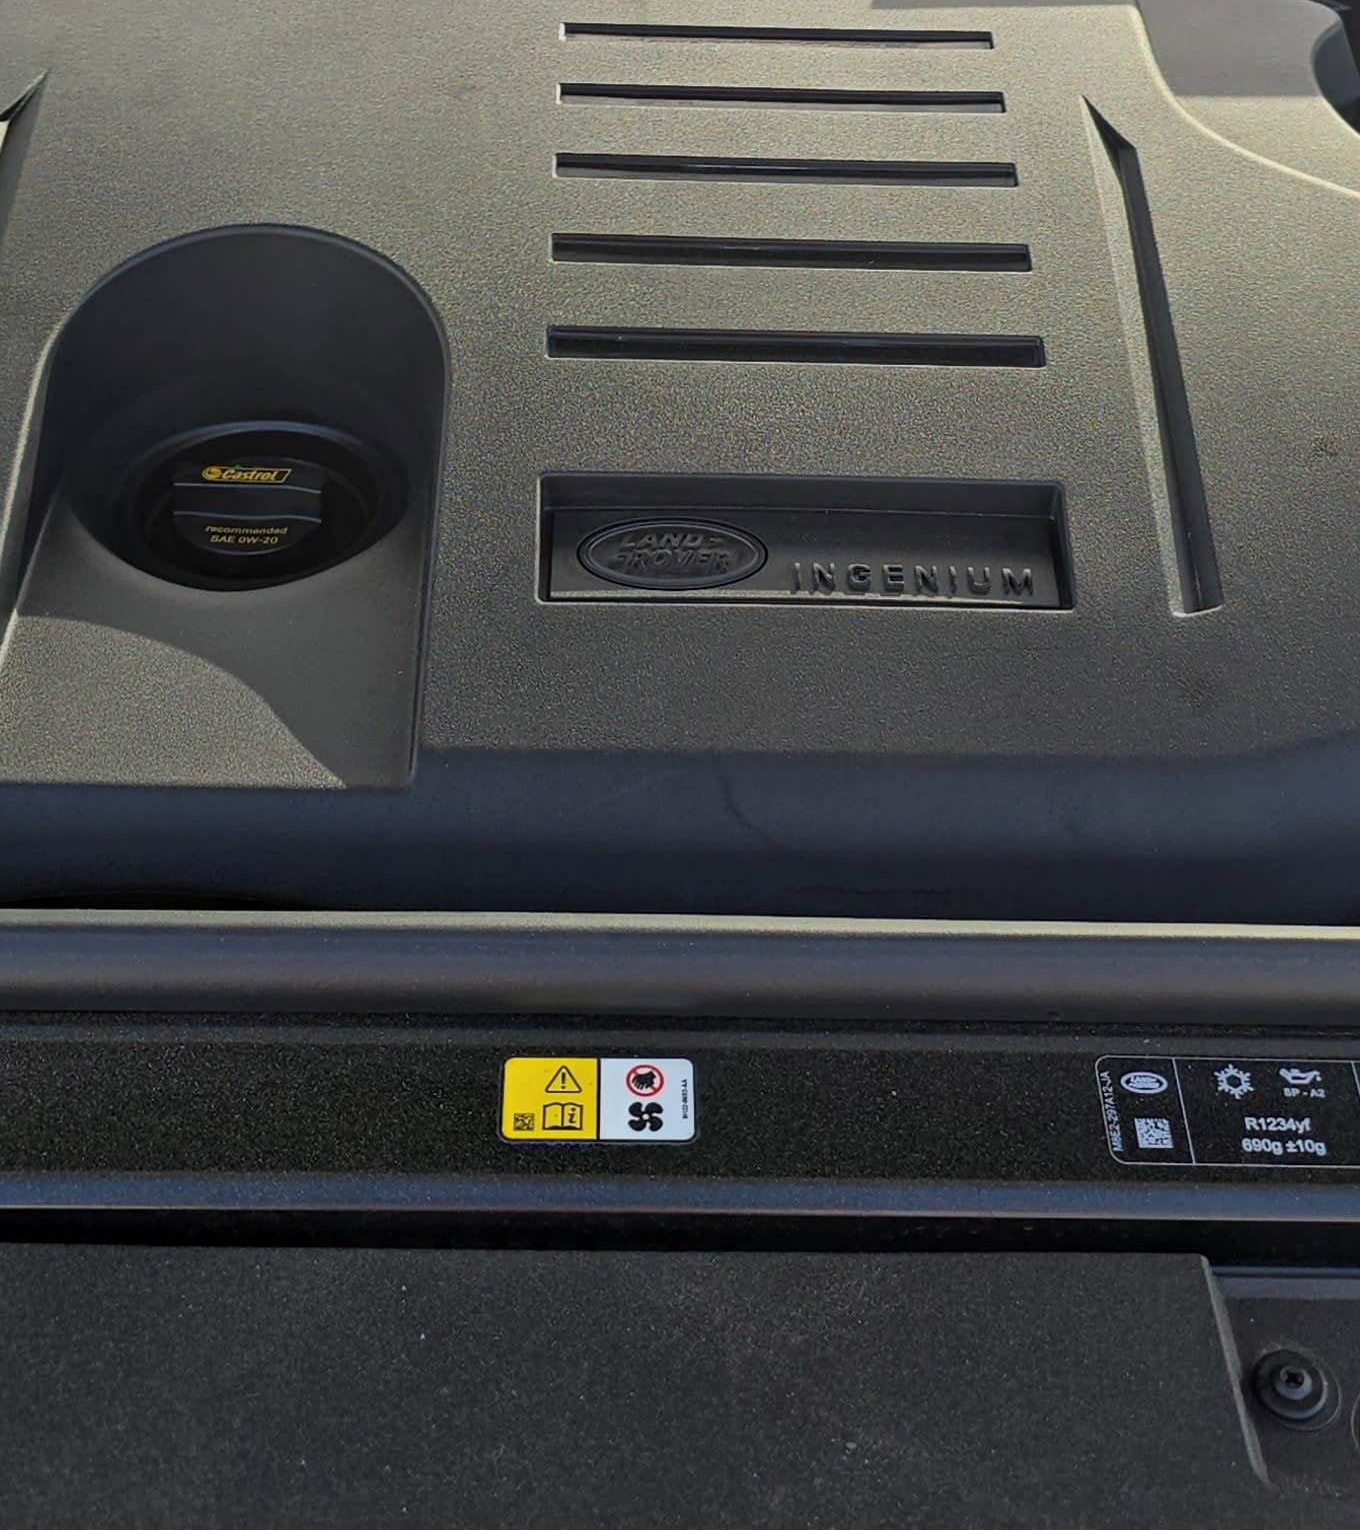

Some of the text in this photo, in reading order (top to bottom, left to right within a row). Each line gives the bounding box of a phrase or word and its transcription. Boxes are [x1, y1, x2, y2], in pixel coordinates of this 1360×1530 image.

[221, 469, 278, 481] Castrol
[205, 525, 288, 534] recommended
[210, 535, 279, 544] SAE 0W-20
[620, 533, 706, 548] LAND
[626, 550, 732, 570] ROVER
[789, 562, 1036, 595] INGENIUM
[1310, 1088, 1326, 1098] A2
[1244, 1117, 1311, 1134] R1234yf
[1241, 1138, 1326, 1156] 690g ±10g
